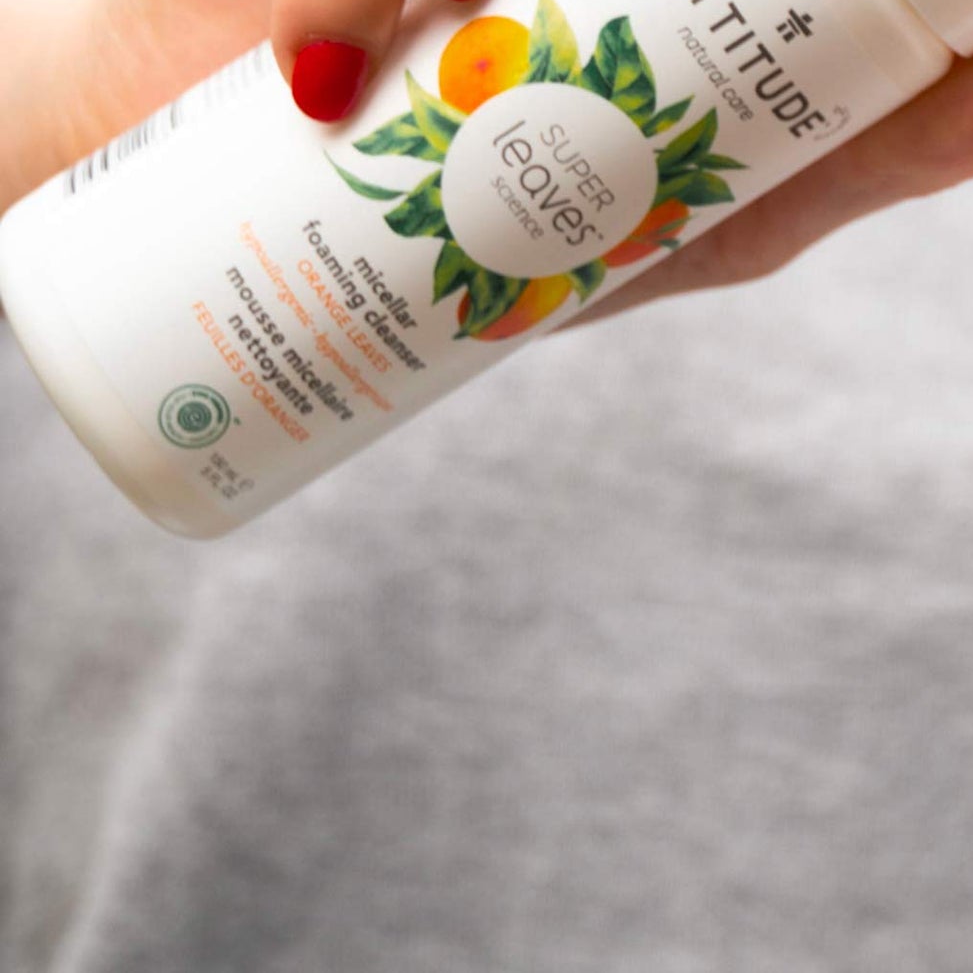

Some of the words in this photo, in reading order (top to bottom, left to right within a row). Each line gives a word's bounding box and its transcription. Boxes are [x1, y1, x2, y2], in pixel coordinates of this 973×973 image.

[678, 26, 731, 89] natural
[721, 87, 754, 122] care
[491, 176, 545, 240] science
[540, 124, 616, 212] SUPER
[297, 259, 352, 329] ORANGE
[302, 219, 367, 310] foaming
[363, 309, 427, 371] cleanser
[353, 255, 418, 329] micellar
[192, 300, 246, 373] FEUILLES
[225, 265, 286, 346] mousse
[282, 348, 354, 421] micellaire
[228, 313, 314, 415] nettoyante
